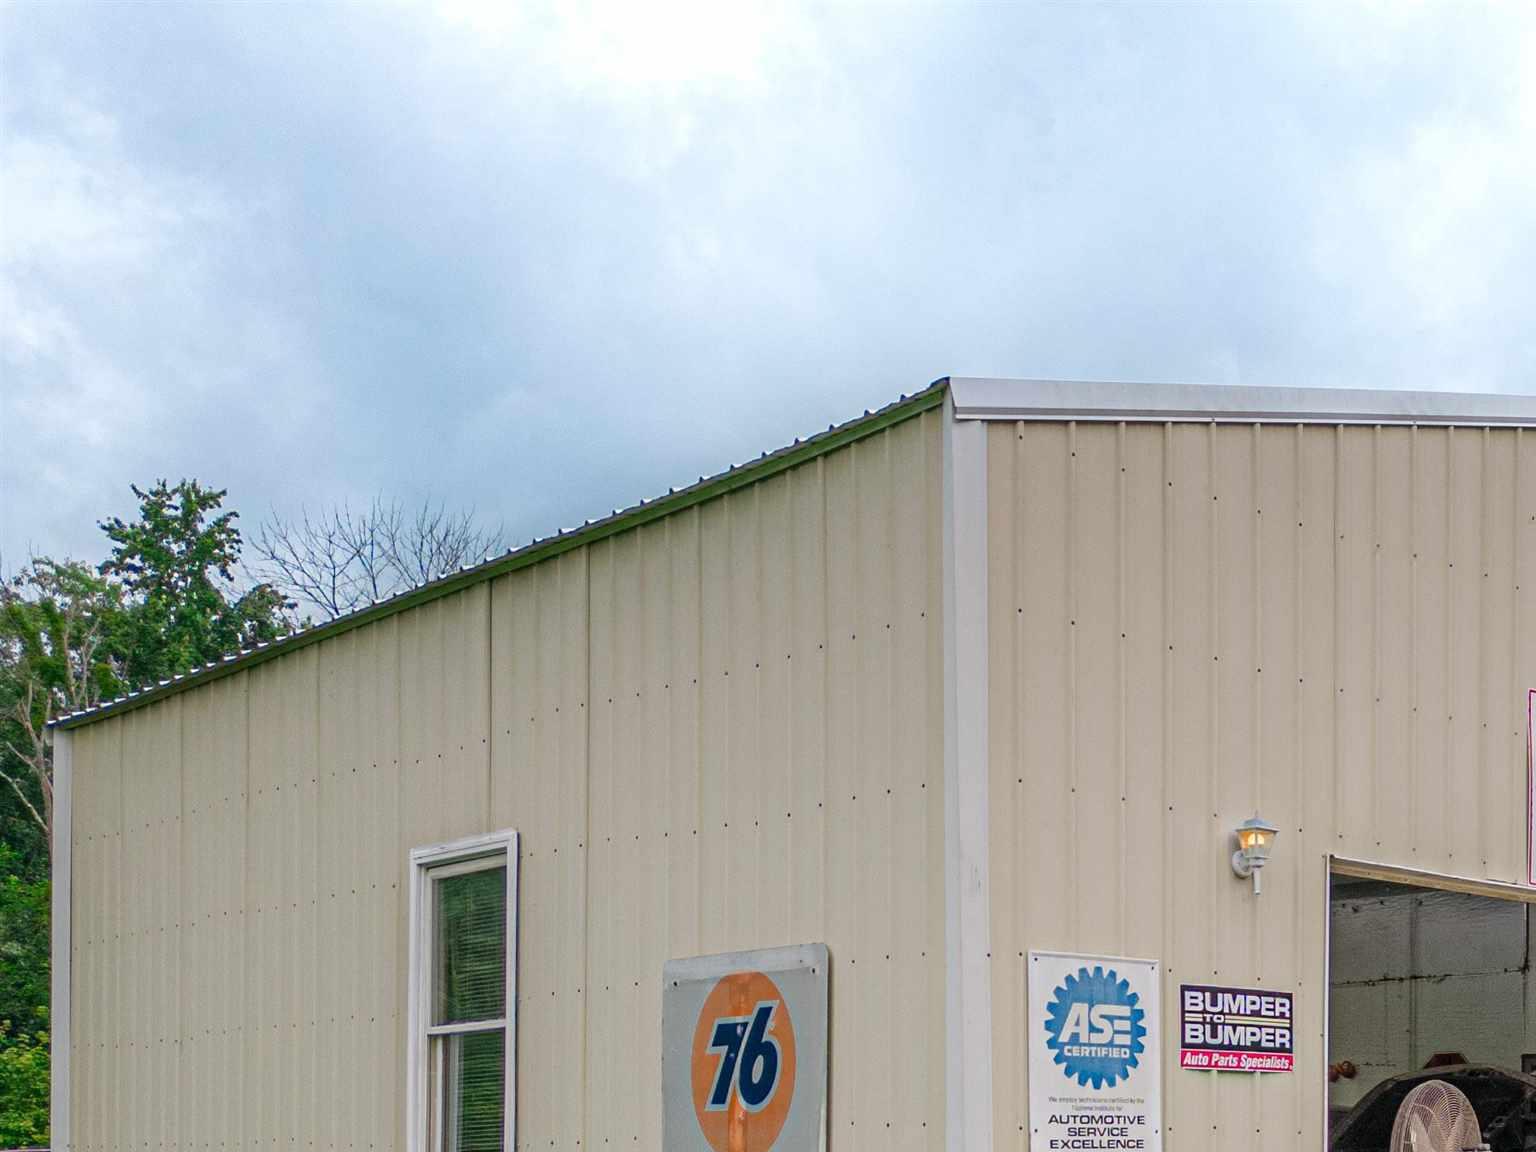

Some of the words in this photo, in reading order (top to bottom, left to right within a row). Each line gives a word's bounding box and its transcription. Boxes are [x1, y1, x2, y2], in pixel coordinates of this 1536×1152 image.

[1184, 990, 1291, 1018] BUMPER
[1058, 1001, 1132, 1046] ASE
[1202, 1013, 1225, 1024] TO
[1184, 1023, 1291, 1049] BUMPER
[706, 1001, 779, 1112] 76
[1063, 1045, 1131, 1059] CERTIFIED
[1183, 1051, 1209, 1067] Auto
[1211, 1053, 1238, 1068] Parts
[1048, 1114, 1145, 1125] AUTOMOTIVE
[1067, 1127, 1129, 1137] SERVICE
[1049, 1139, 1145, 1149] EXCELLENCE
